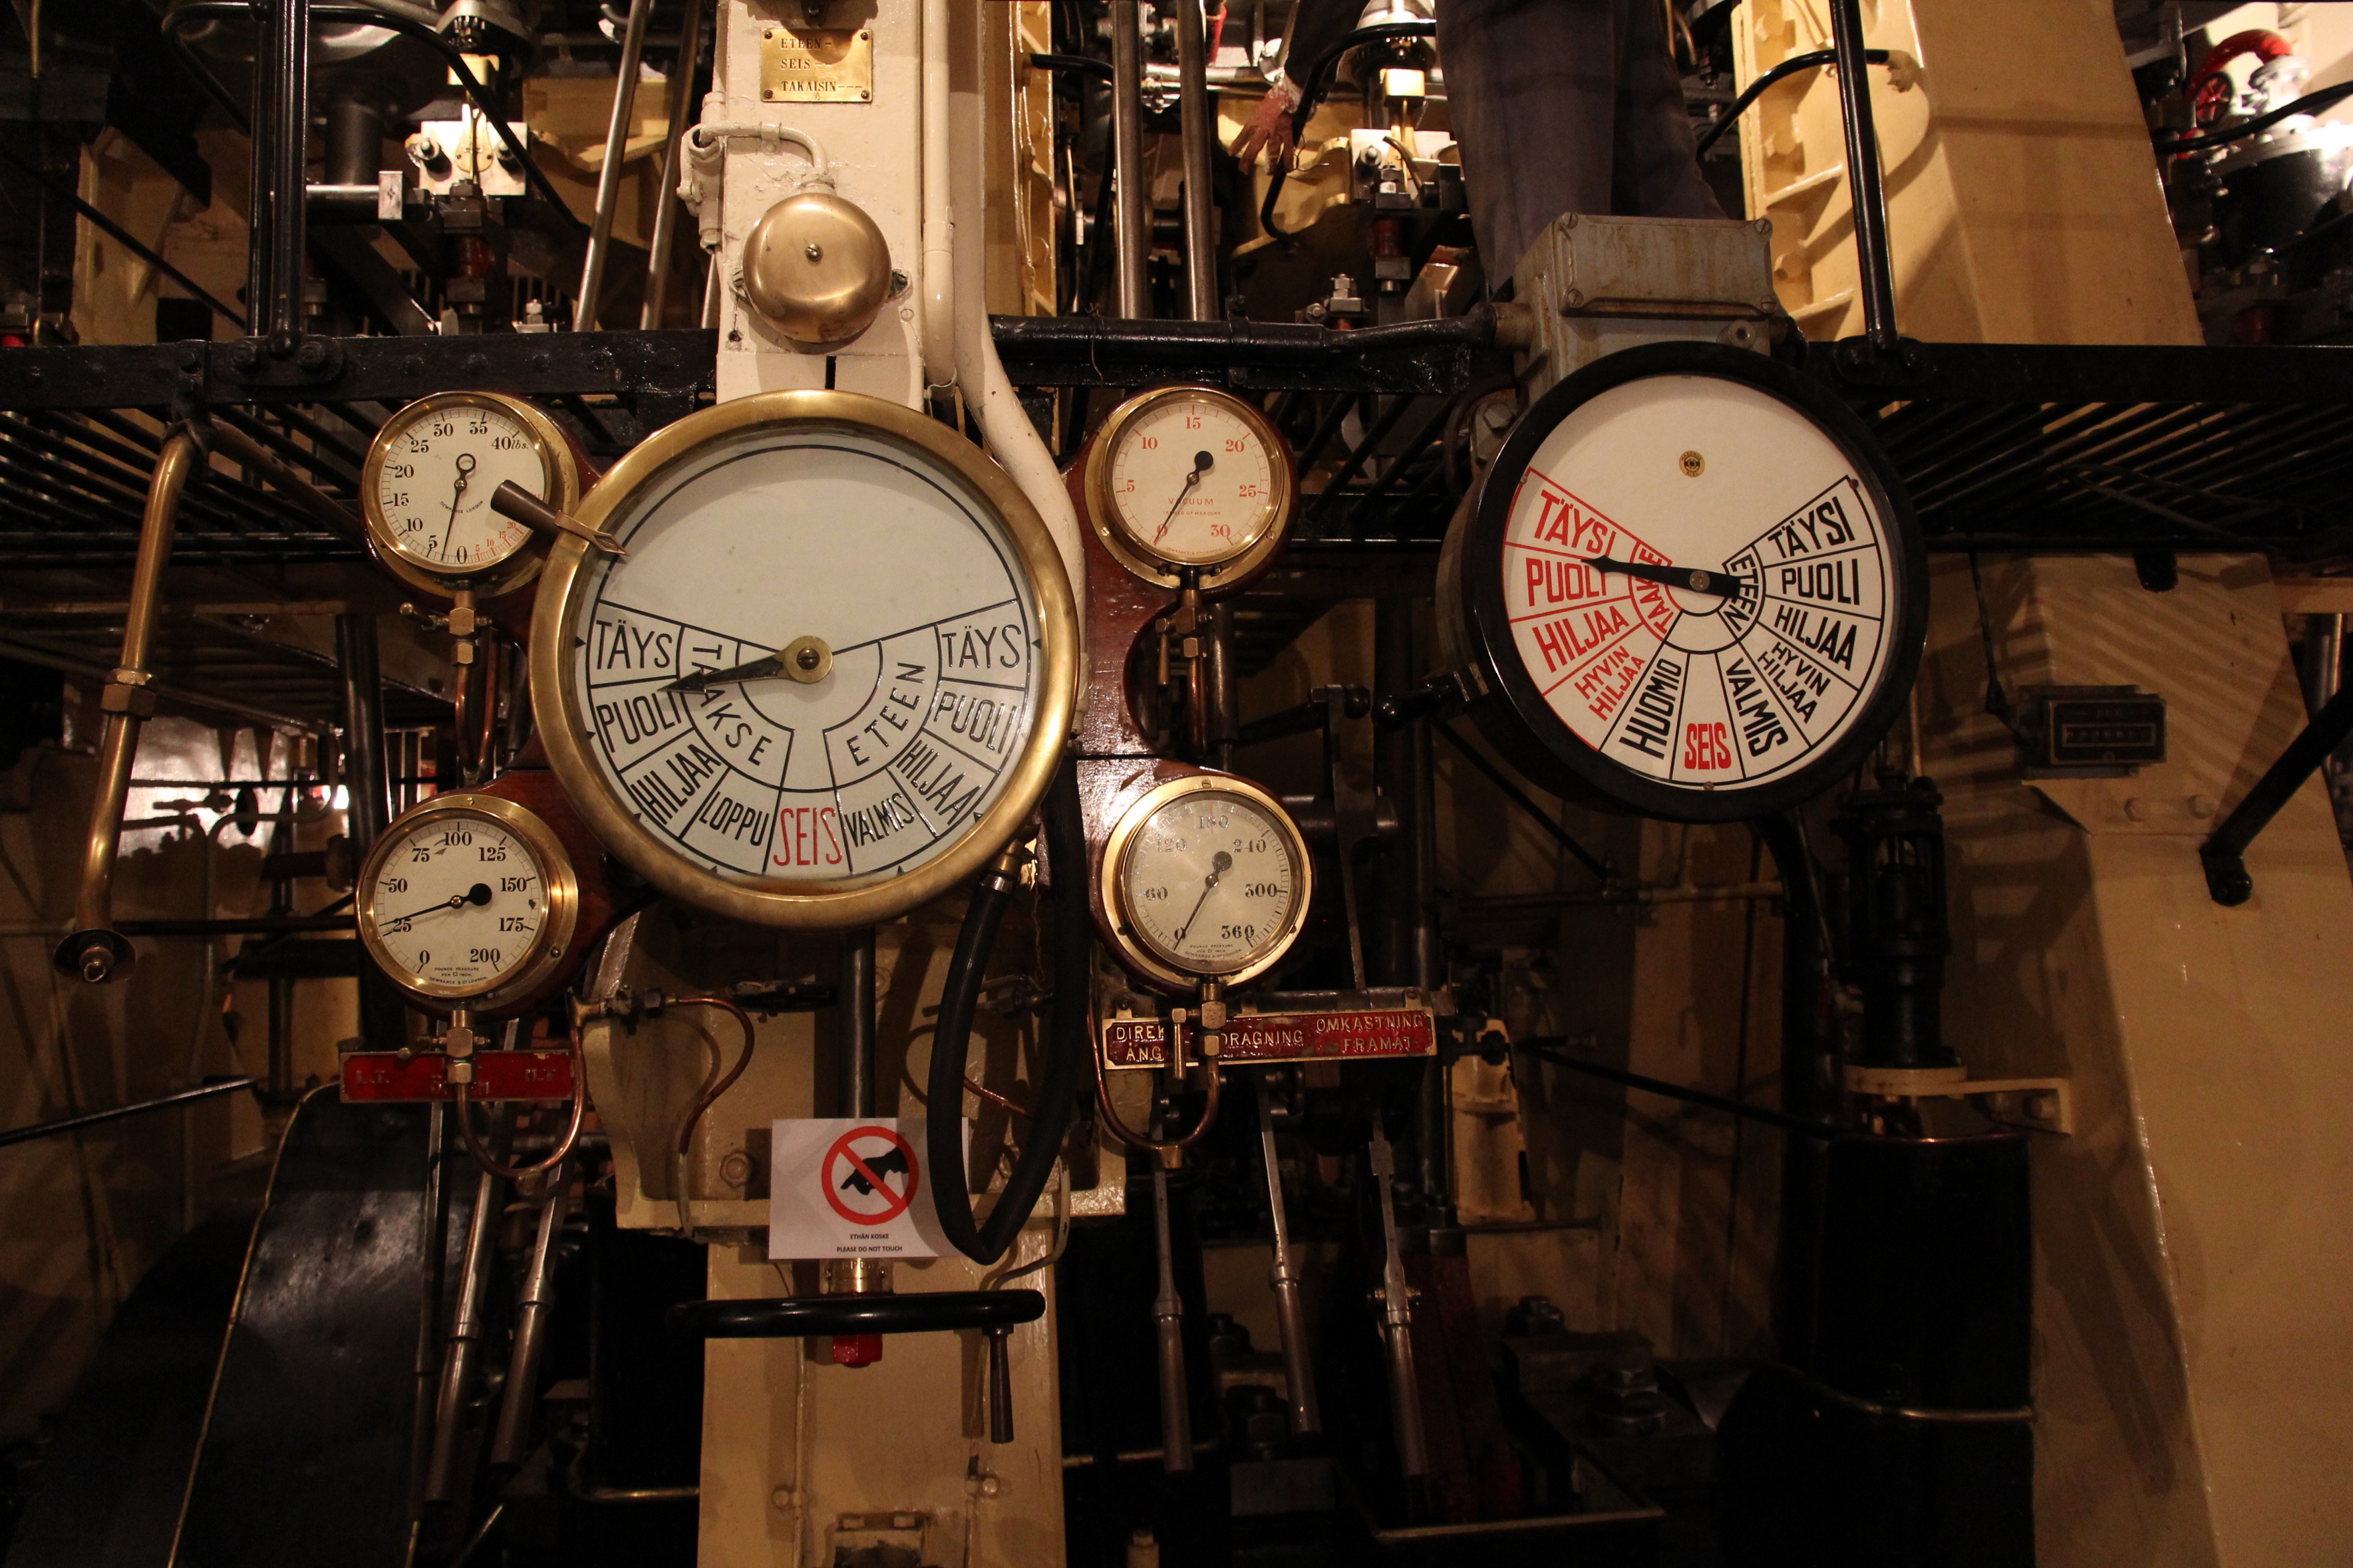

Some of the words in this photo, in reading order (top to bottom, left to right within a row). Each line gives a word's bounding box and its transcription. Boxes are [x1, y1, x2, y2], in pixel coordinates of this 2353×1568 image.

[781, 59, 811, 70] SEIS
[434, 423, 454, 436] 30
[469, 421, 488, 435] 35
[1186, 417, 1201, 429] 15
[411, 439, 429, 453] 25
[1141, 437, 1158, 449] 10
[1225, 439, 1244, 452] 20
[395, 465, 414, 478] 20
[1126, 480, 1135, 492] 5
[1239, 485, 1257, 498] 25
[393, 493, 409, 506] 15
[439, 501, 464, 513] DEWRCE
[466, 501, 483, 513] LONDON
[406, 518, 423, 532] 10
[1157, 524, 1168, 536] 0
[1534, 489, 1616, 557] TÄYSI
[1768, 496, 1855, 558] TÄYSI
[1211, 525, 1231, 538] 30
[428, 535, 438, 548] 5
[486, 539, 494, 547] 10
[456, 546, 467, 564] 0
[1525, 558, 1607, 607] PUOLI
[1781, 558, 1859, 605] PUOLI
[1635, 548, 1674, 635] TAAKE
[596, 619, 672, 669] TÄYS
[1532, 606, 1629, 673] HILJAA
[1774, 605, 1857, 671] HILJAA
[942, 625, 1021, 669] TÄYS
[1574, 645, 1630, 700] HYVIN
[1773, 642, 1831, 697] HYVIN
[1588, 656, 1646, 722] HILJAA
[1757, 651, 1818, 724] HILJAA
[846, 662, 926, 766] ETEEN
[1619, 658, 1682, 760] HUOMIO
[1726, 657, 1789, 757] VALMIS
[596, 692, 682, 753] PUOLI
[934, 691, 1018, 755] PUOLI
[1684, 722, 1732, 770] SEIS
[630, 744, 721, 825] HILJAA
[896, 739, 982, 825] HILJAA
[699, 791, 769, 847] LOPPU
[844, 792, 915, 848] VALMIS
[1198, 815, 1229, 829] 180
[444, 832, 472, 846] 100
[774, 807, 842, 866] SEIS
[1234, 839, 1266, 852] 240
[412, 848, 430, 862] 75
[479, 847, 506, 862] 125
[388, 879, 408, 893] 50
[501, 878, 527, 892] 150
[1245, 883, 1277, 898] 300
[1146, 887, 1168, 900] 60
[393, 918, 412, 932] 25
[499, 918, 524, 932] 175
[1222, 925, 1254, 939] 360
[1175, 927, 1186, 941] 0
[419, 950, 430, 965] 0
[470, 949, 500, 963] 200
[1317, 1015, 1424, 1033] OMKASTNING
[1116, 1025, 1165, 1041] DIREK
